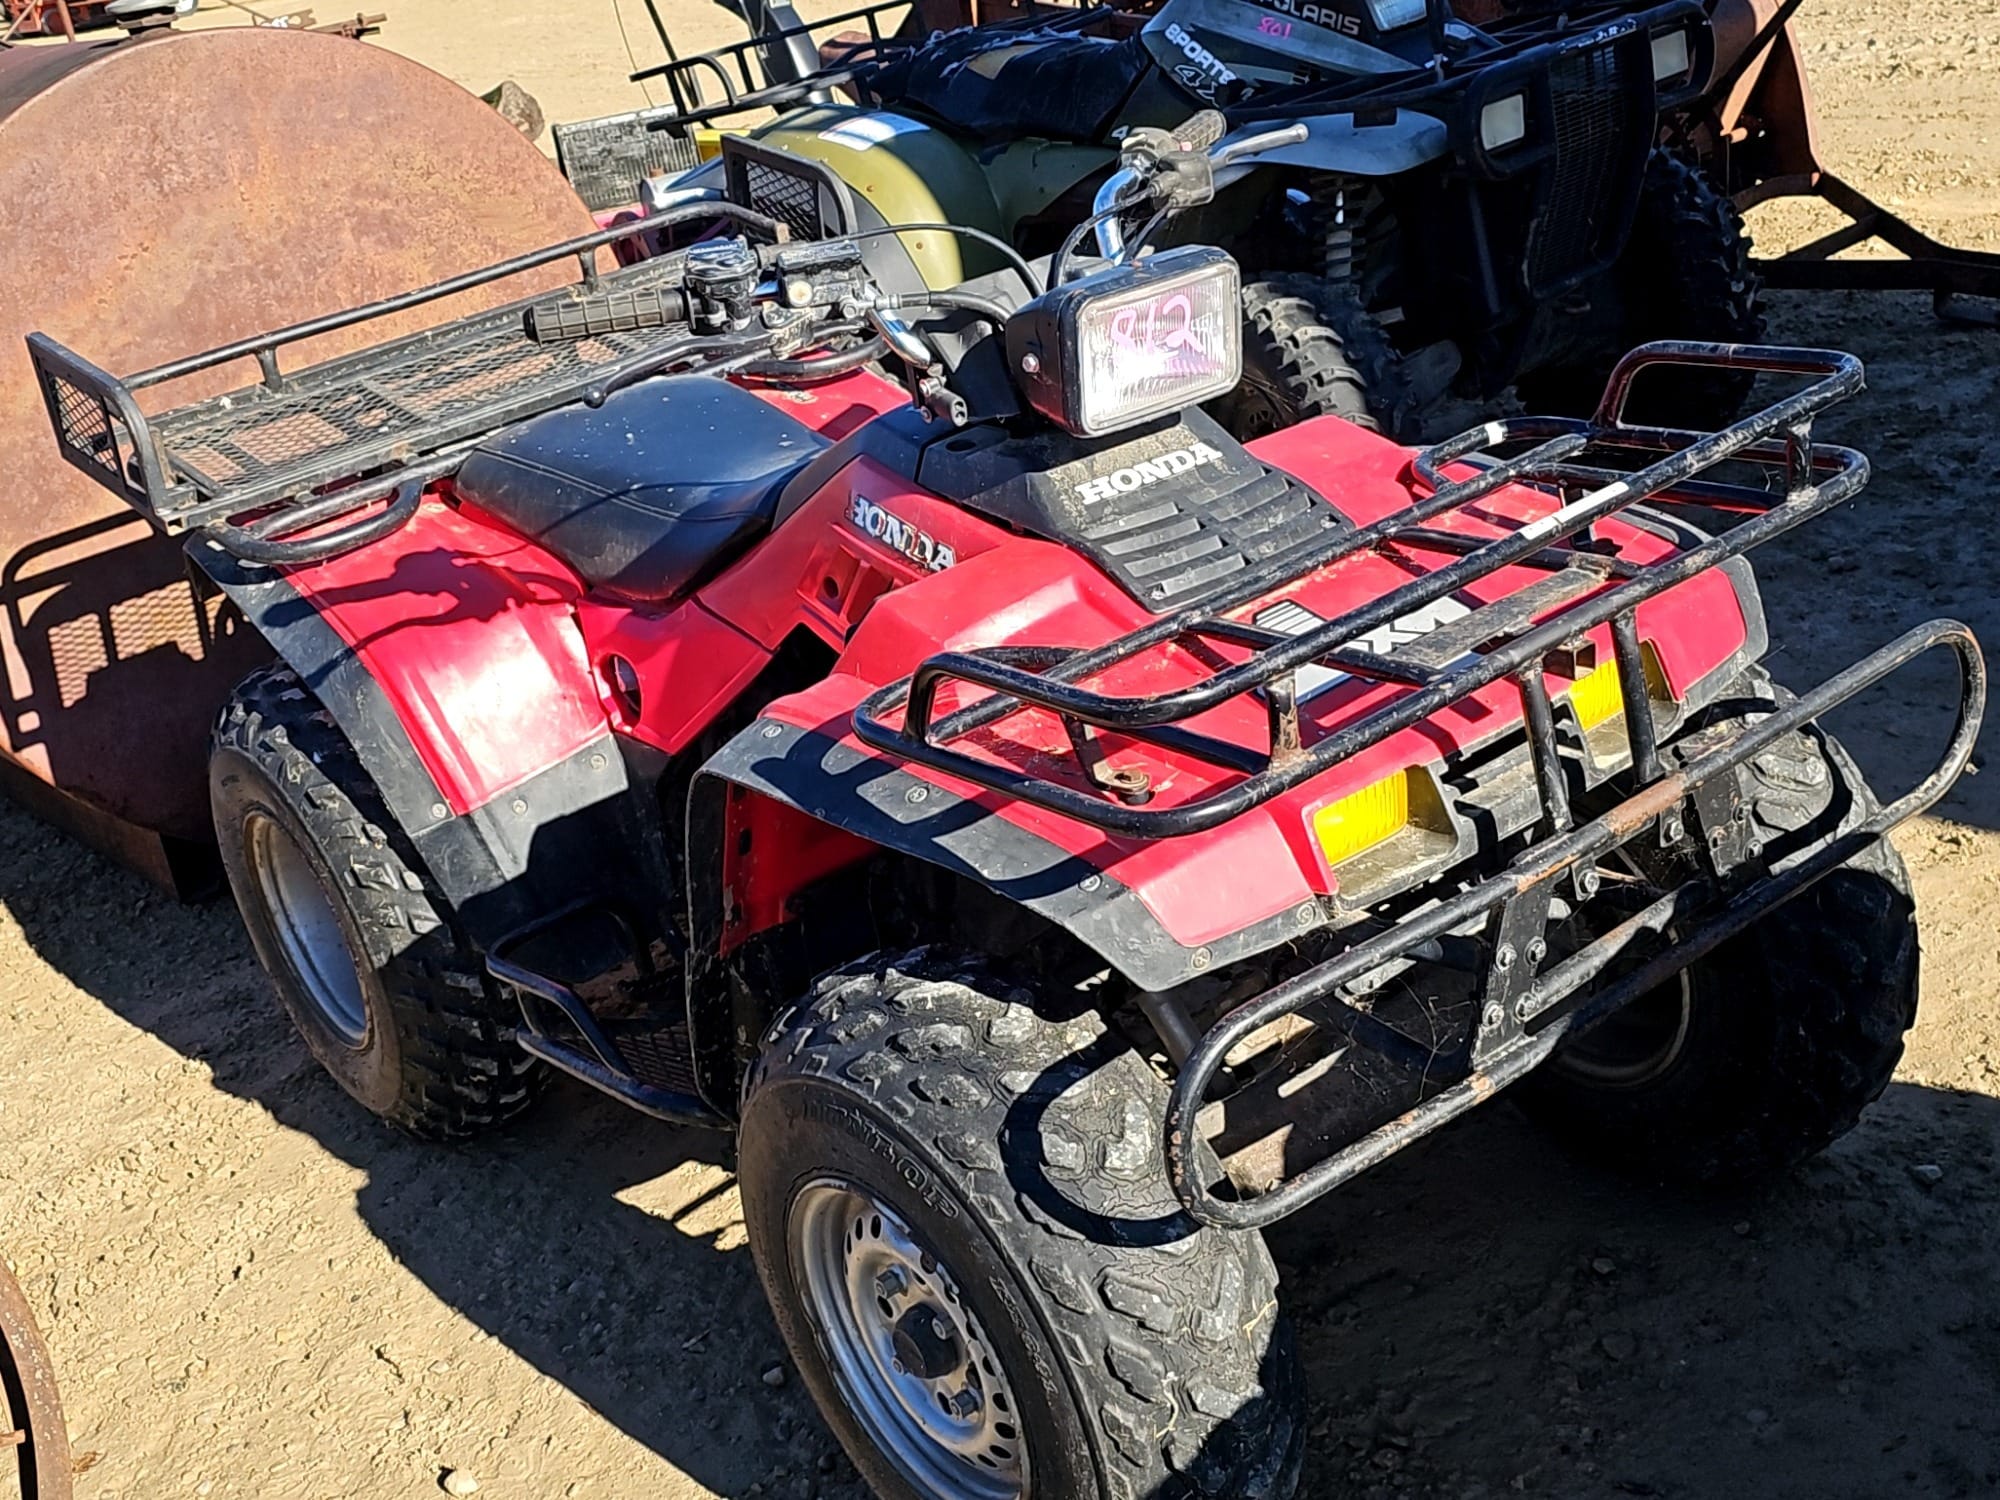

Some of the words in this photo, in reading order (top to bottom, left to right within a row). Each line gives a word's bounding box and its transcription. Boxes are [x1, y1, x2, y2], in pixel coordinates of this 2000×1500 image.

[1258, 0, 1361, 36] OLARIS
[1074, 441, 1223, 505] HONDA
[849, 495, 957, 573] HONDA
